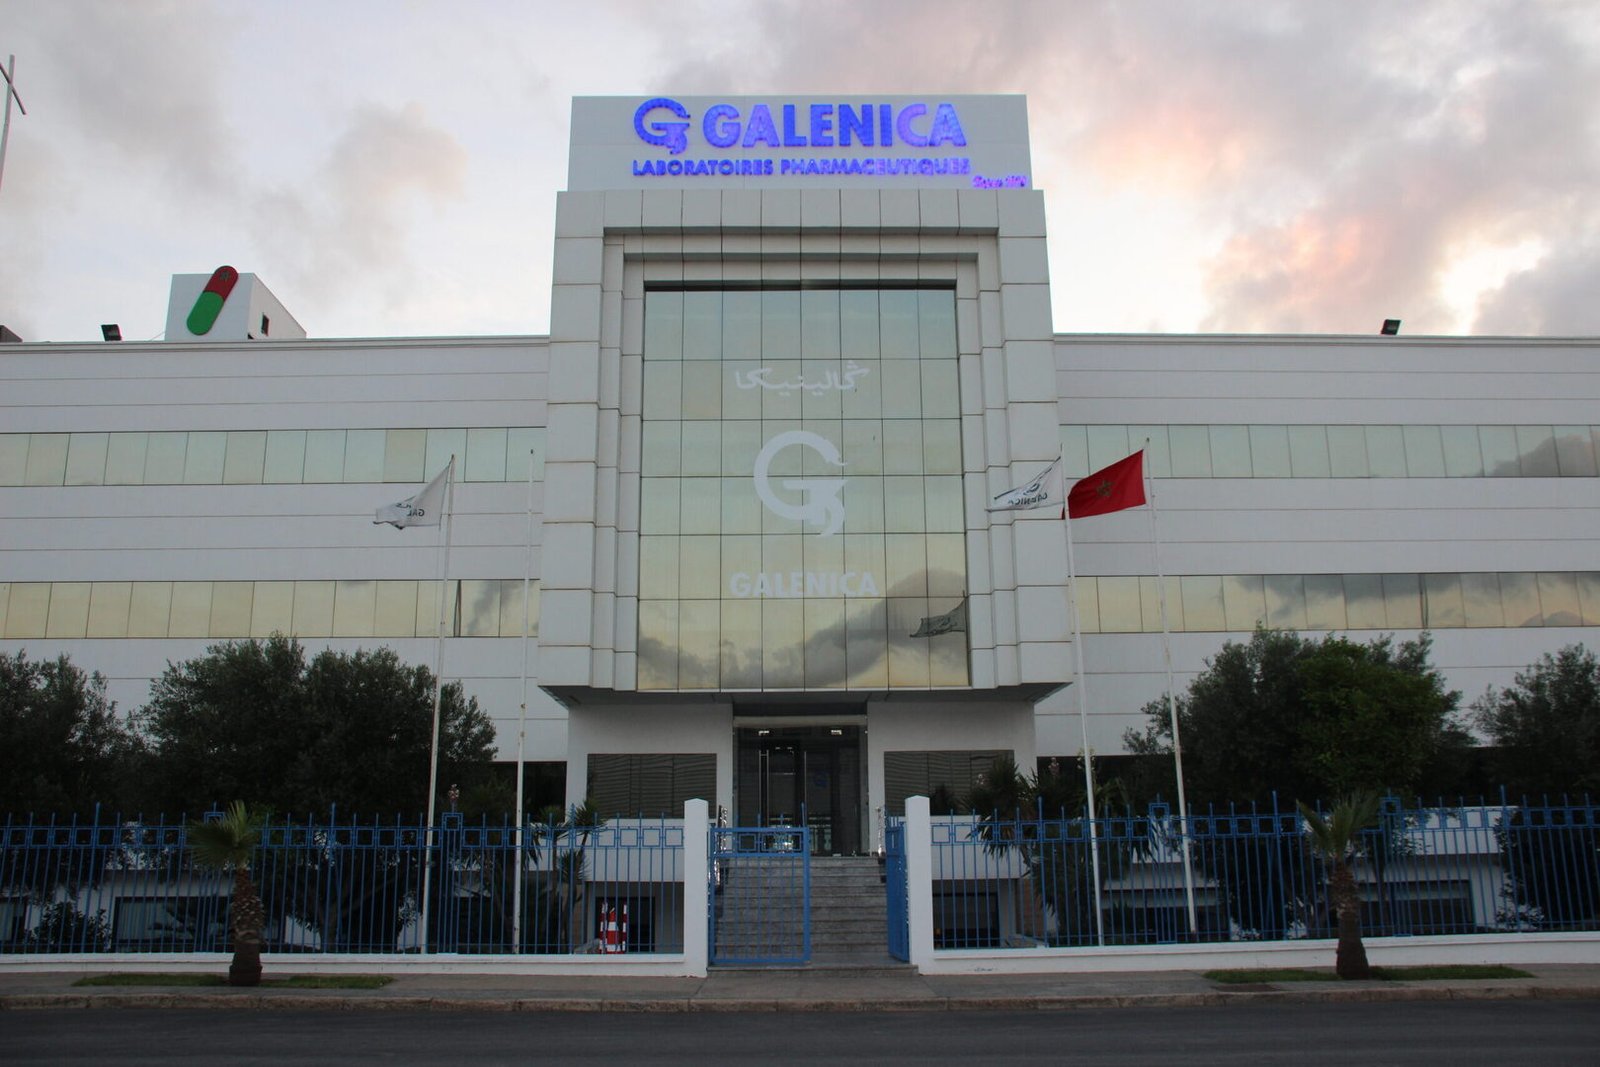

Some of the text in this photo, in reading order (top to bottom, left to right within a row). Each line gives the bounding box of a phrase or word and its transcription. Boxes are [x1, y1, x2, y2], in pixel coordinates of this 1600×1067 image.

[703, 103, 967, 148] GALENICA
[632, 158, 970, 176] LABORATOIRES PHARMACEUTIQUES
[729, 570, 879, 598] GALENICA
